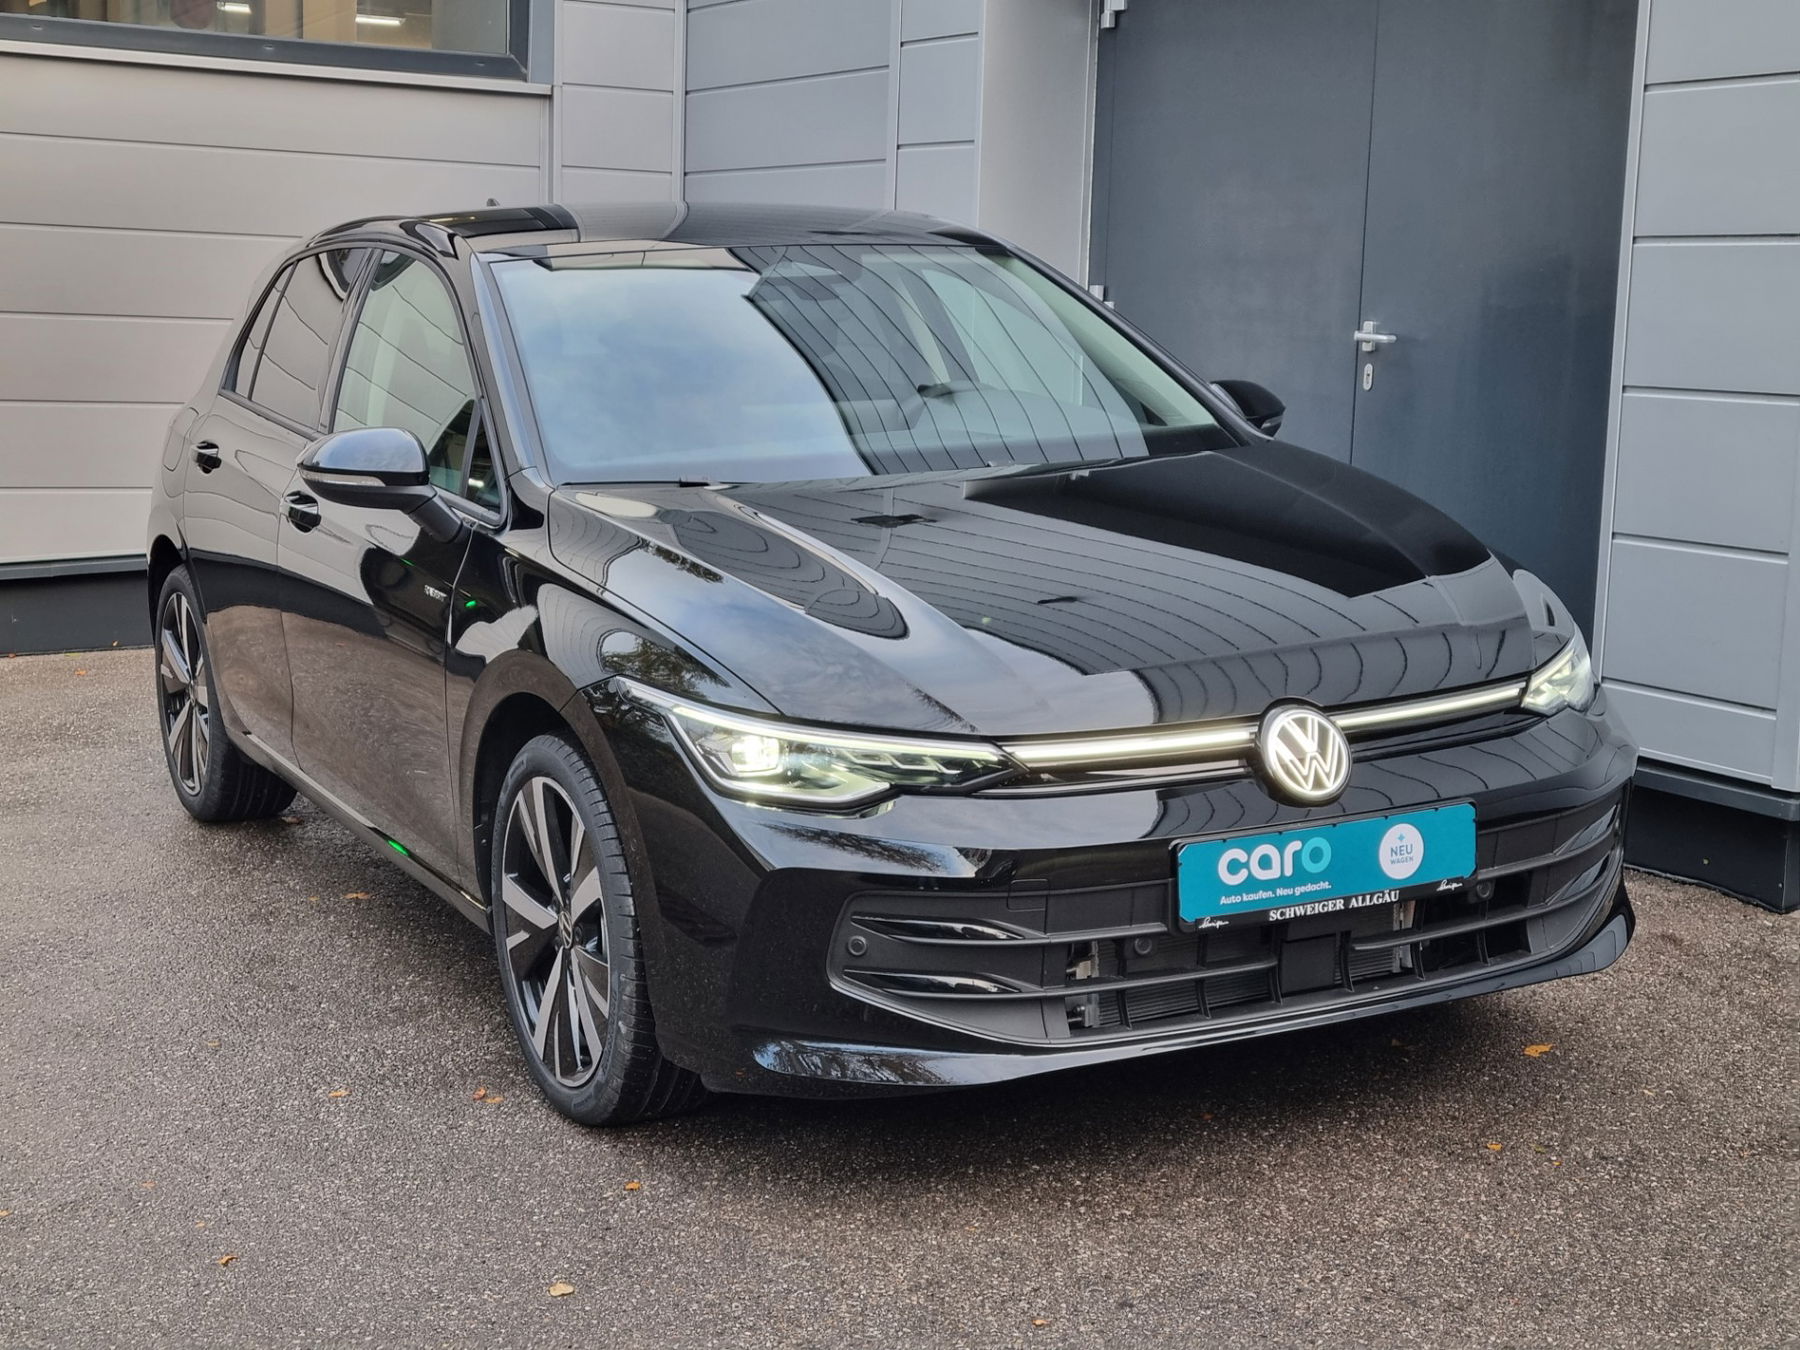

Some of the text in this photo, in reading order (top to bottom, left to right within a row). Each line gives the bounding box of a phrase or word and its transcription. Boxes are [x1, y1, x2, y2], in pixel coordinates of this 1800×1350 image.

[1217, 836, 1332, 886] caro
[1390, 844, 1413, 858] NEU
[1390, 856, 1414, 865] WAGEN
[1220, 881, 1332, 905] Auto kaufen. Neu gedacht.
[1268, 889, 1400, 921] SCHWEIGER ALLGÄU
